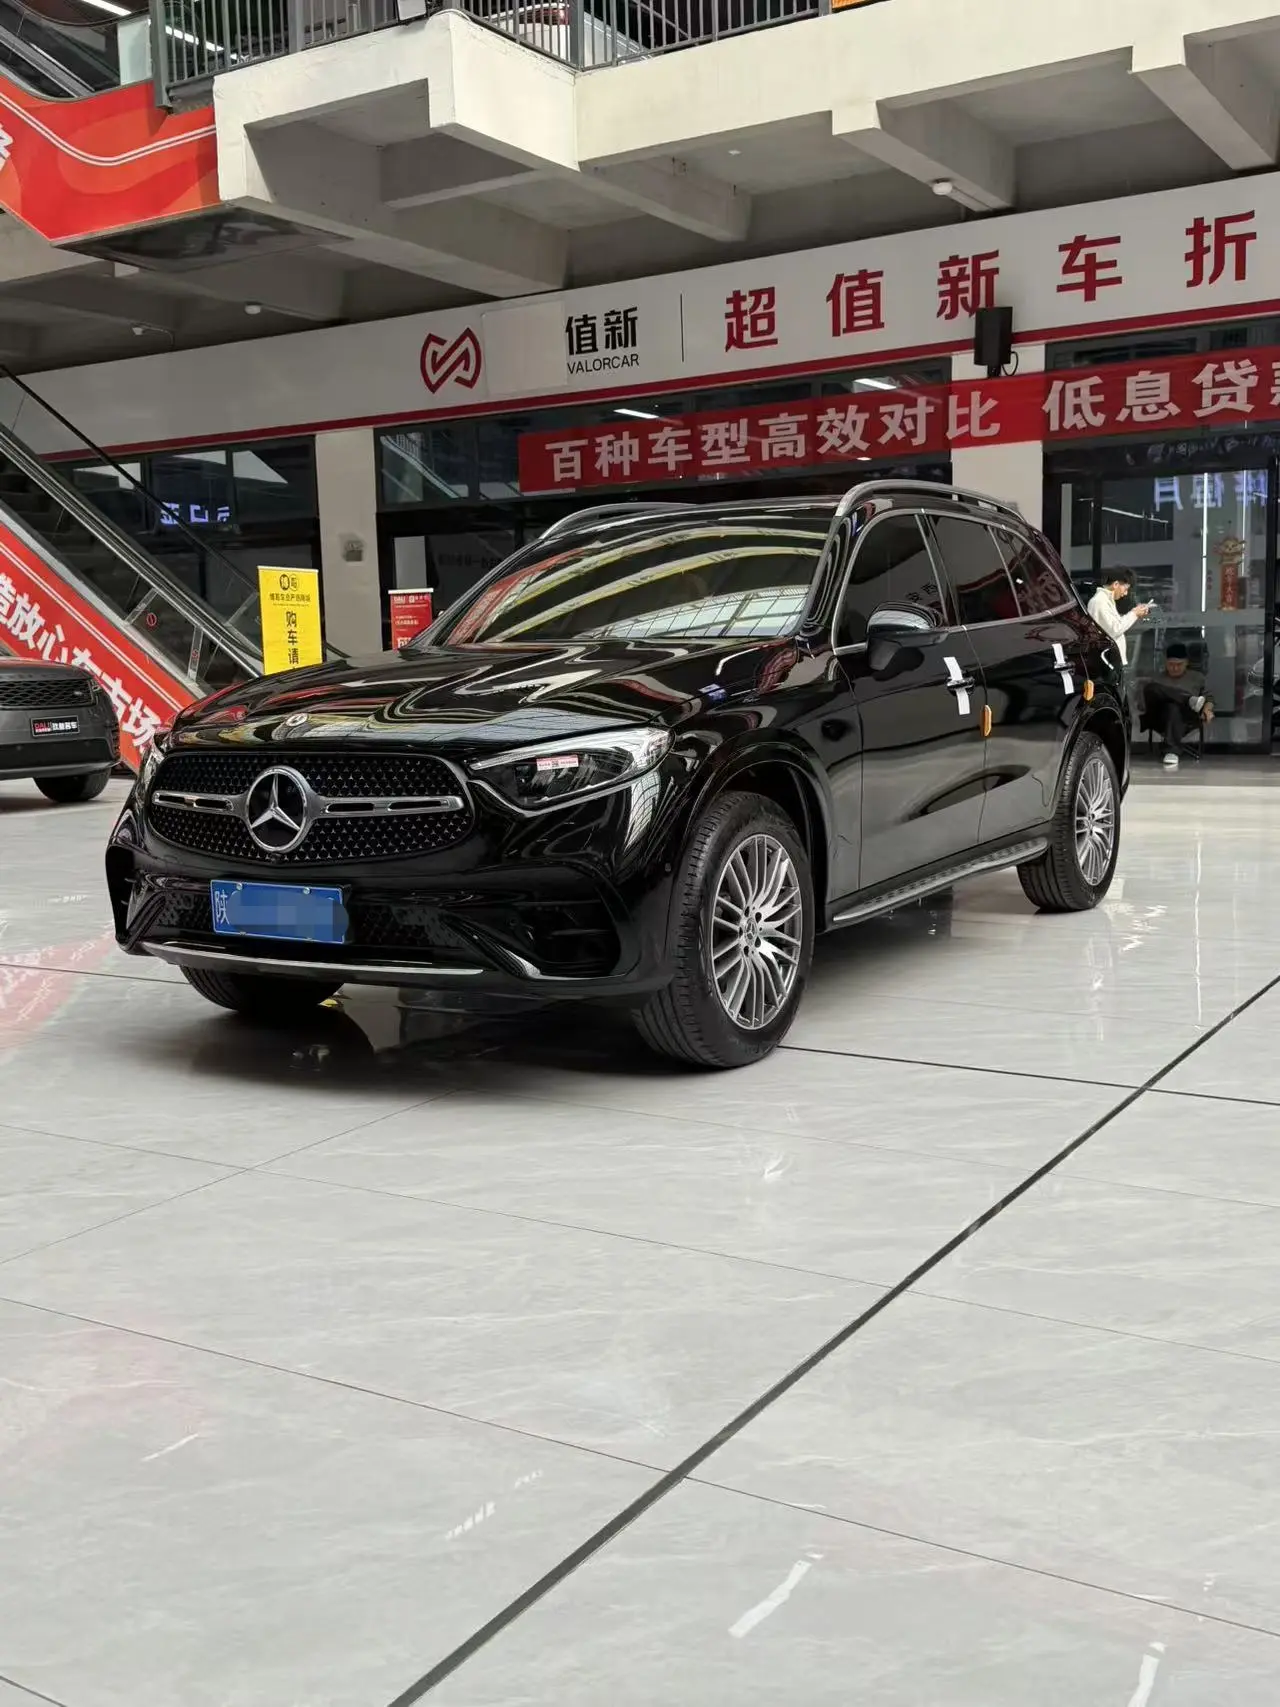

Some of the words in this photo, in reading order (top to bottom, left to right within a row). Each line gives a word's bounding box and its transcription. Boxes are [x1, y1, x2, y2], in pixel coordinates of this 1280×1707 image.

[724, 209, 1258, 353] 超值新车折
[565, 306, 638, 356] 值新
[567, 353, 640, 375] VALORCAR
[545, 391, 1000, 482] 百种车型高效对比
[1042, 359, 1280, 432] 低息贷
[285, 610, 299, 668] 购车请
